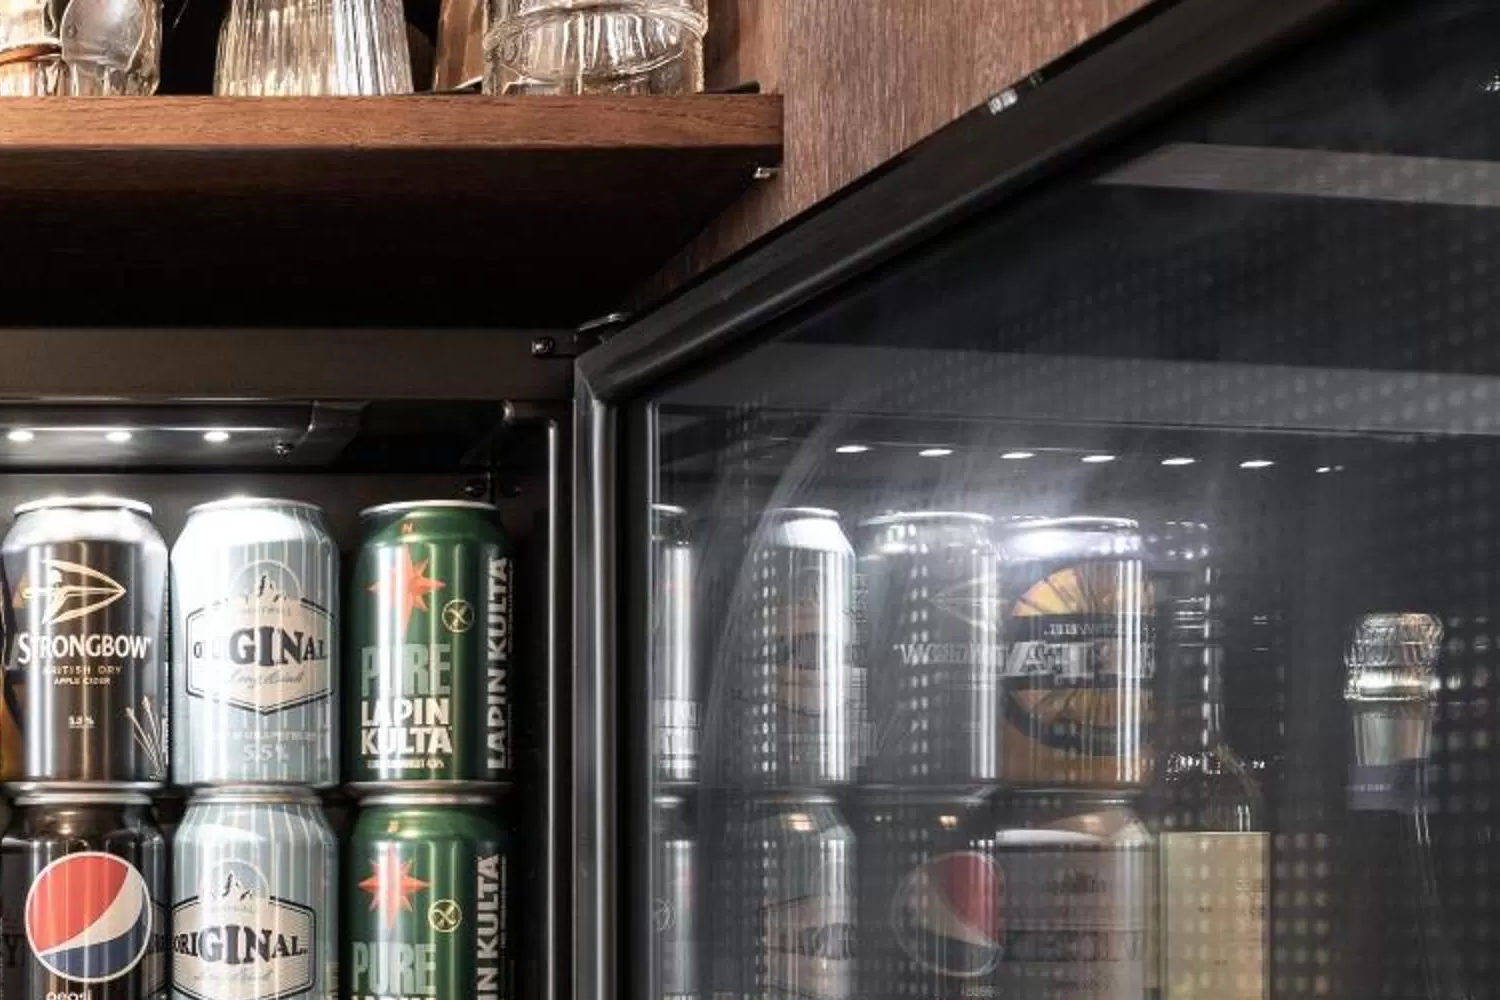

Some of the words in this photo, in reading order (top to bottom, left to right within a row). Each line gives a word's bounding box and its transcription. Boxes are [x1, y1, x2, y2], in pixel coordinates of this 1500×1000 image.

[487, 556, 508, 661] KULTA
[361, 698, 449, 726] LAPIN
[361, 726, 452, 755] KULTA
[487, 668, 507, 769] LAPIN
[477, 855, 499, 959] KULTA
[352, 941, 436, 994] PURE
